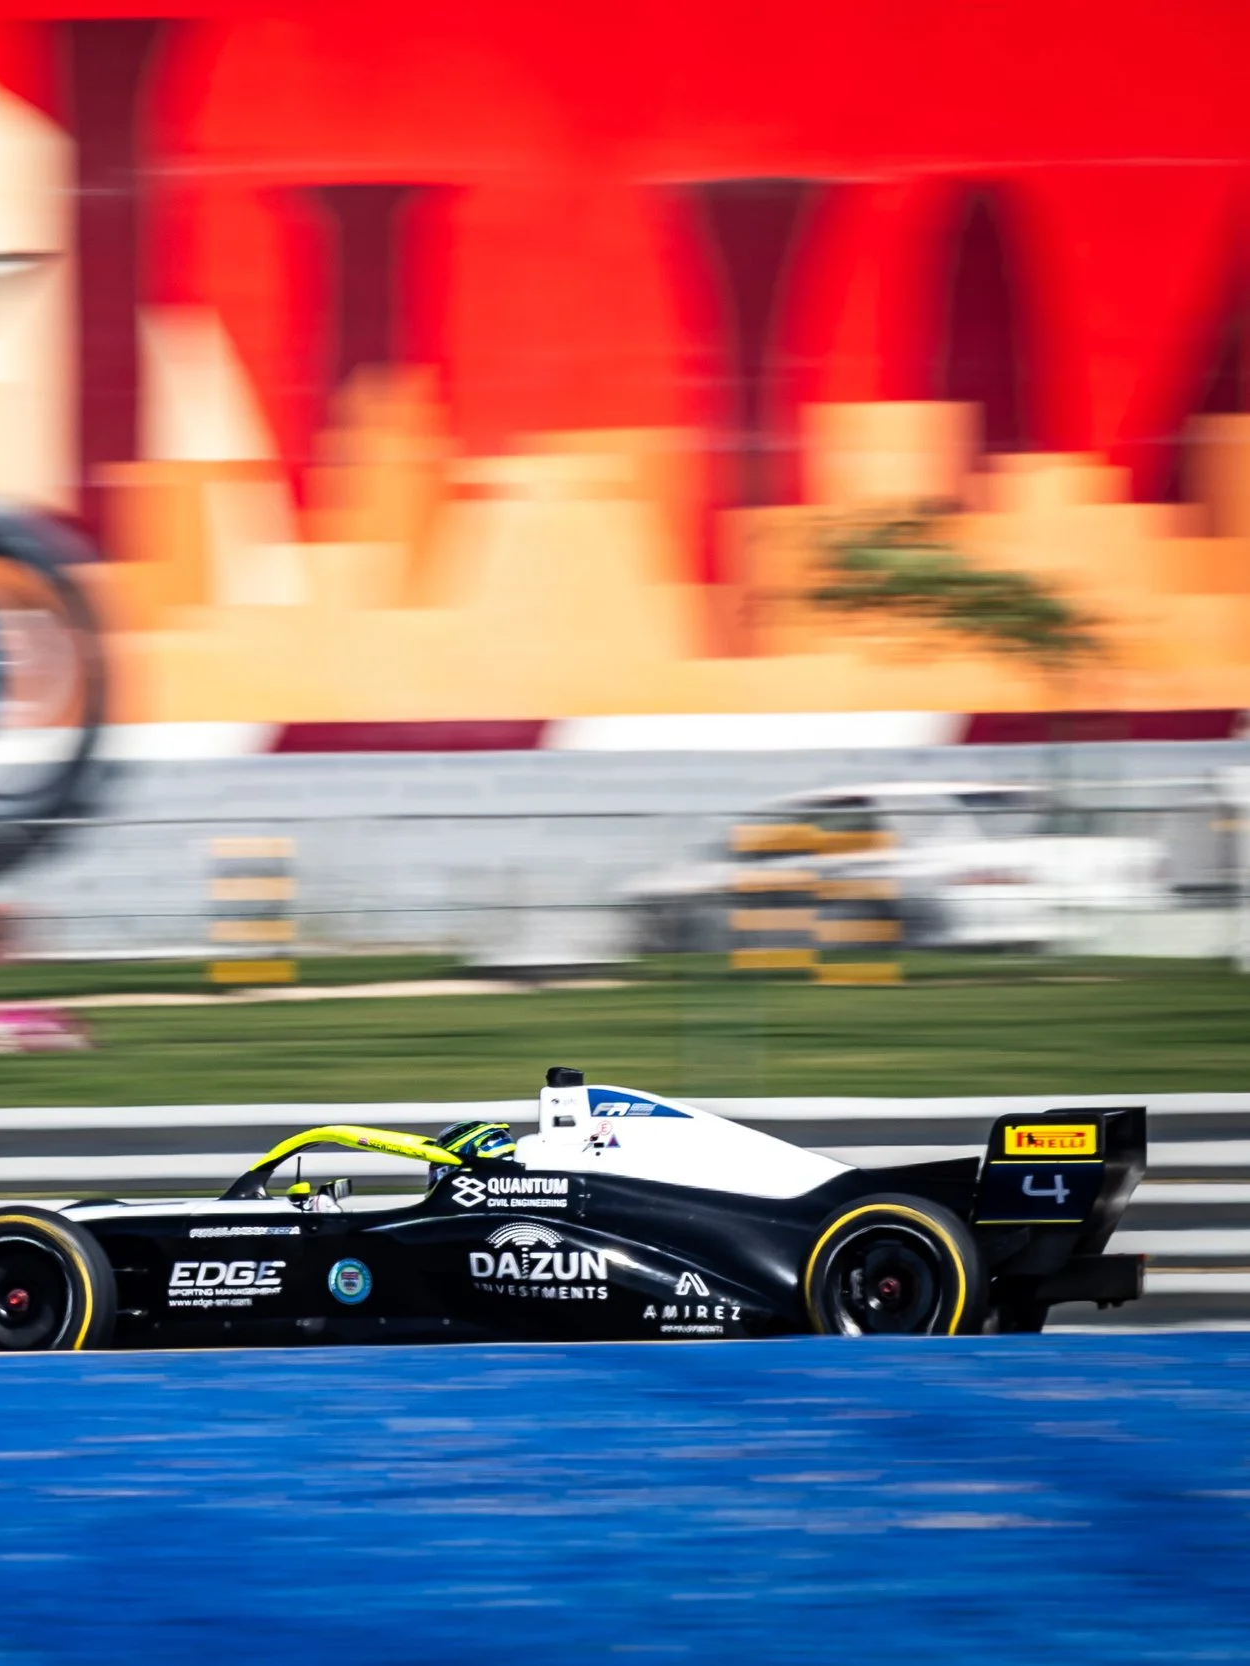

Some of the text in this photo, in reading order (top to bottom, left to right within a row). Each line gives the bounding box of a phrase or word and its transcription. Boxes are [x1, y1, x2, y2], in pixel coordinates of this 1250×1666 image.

[487, 1178, 569, 1194] QUANTUM
[1022, 1174, 1070, 1204] 4
[487, 1198, 568, 1207] CIVIL ENGINEERING
[168, 1261, 286, 1286] EDGE
[168, 1287, 282, 1296] SPORTING MANAGEMENT
[473, 1282, 608, 1299] INVESTMENTS
[643, 1304, 741, 1321] AMIREZ
